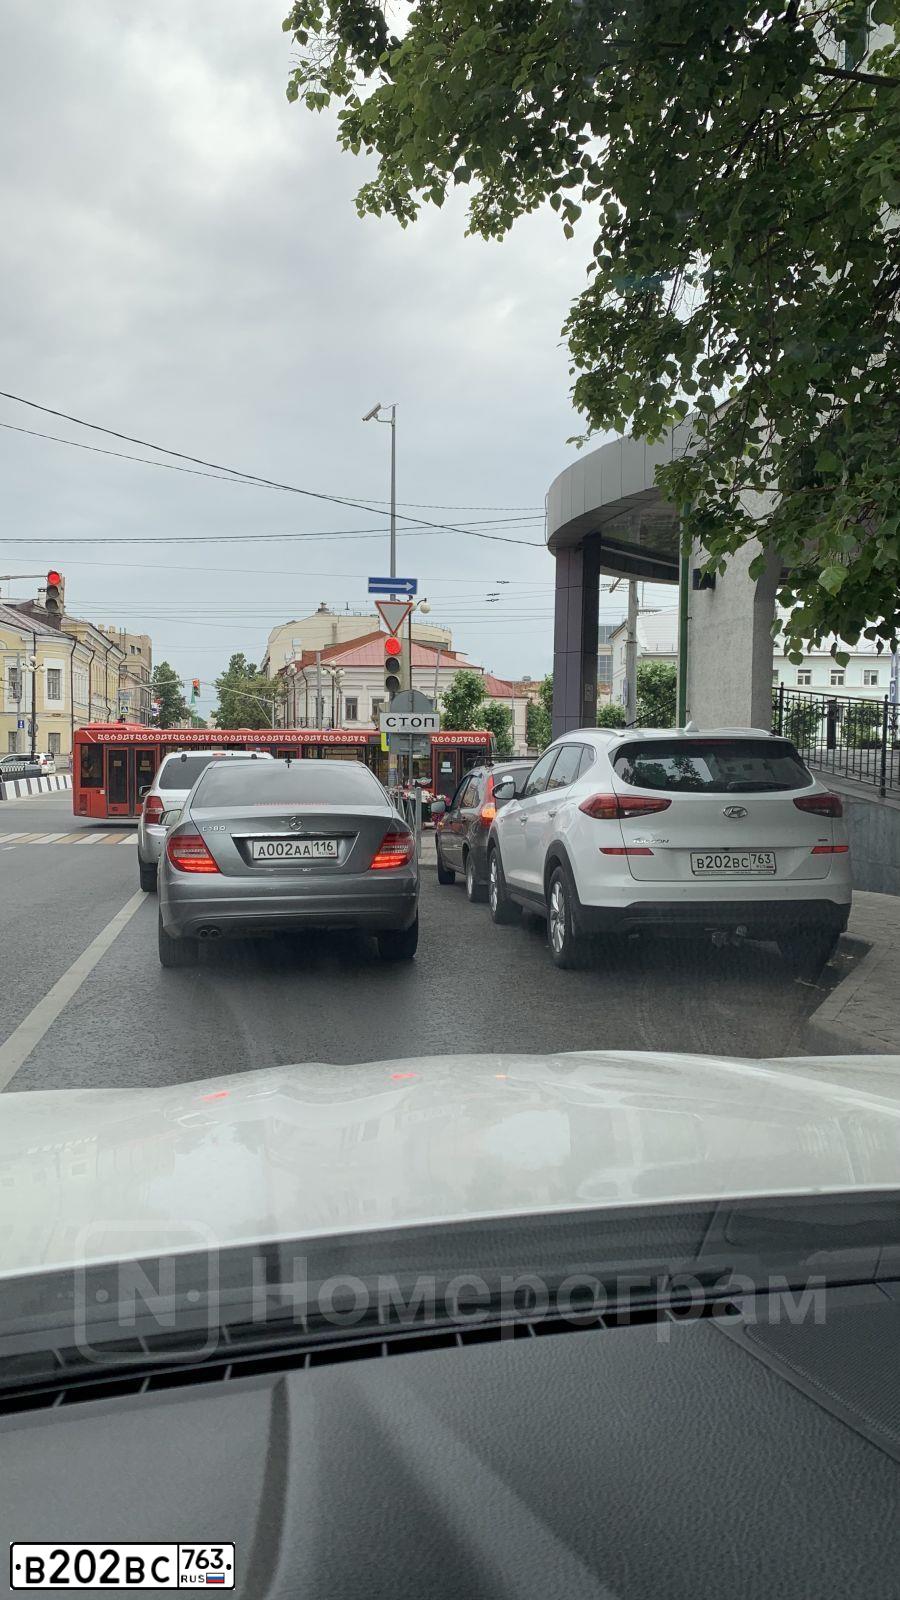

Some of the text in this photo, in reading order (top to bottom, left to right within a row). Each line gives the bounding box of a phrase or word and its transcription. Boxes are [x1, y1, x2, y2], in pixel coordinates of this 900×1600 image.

[386, 717, 435, 728] СТОП
[313, 841, 334, 851] 116
[751, 853, 771, 865] 763
